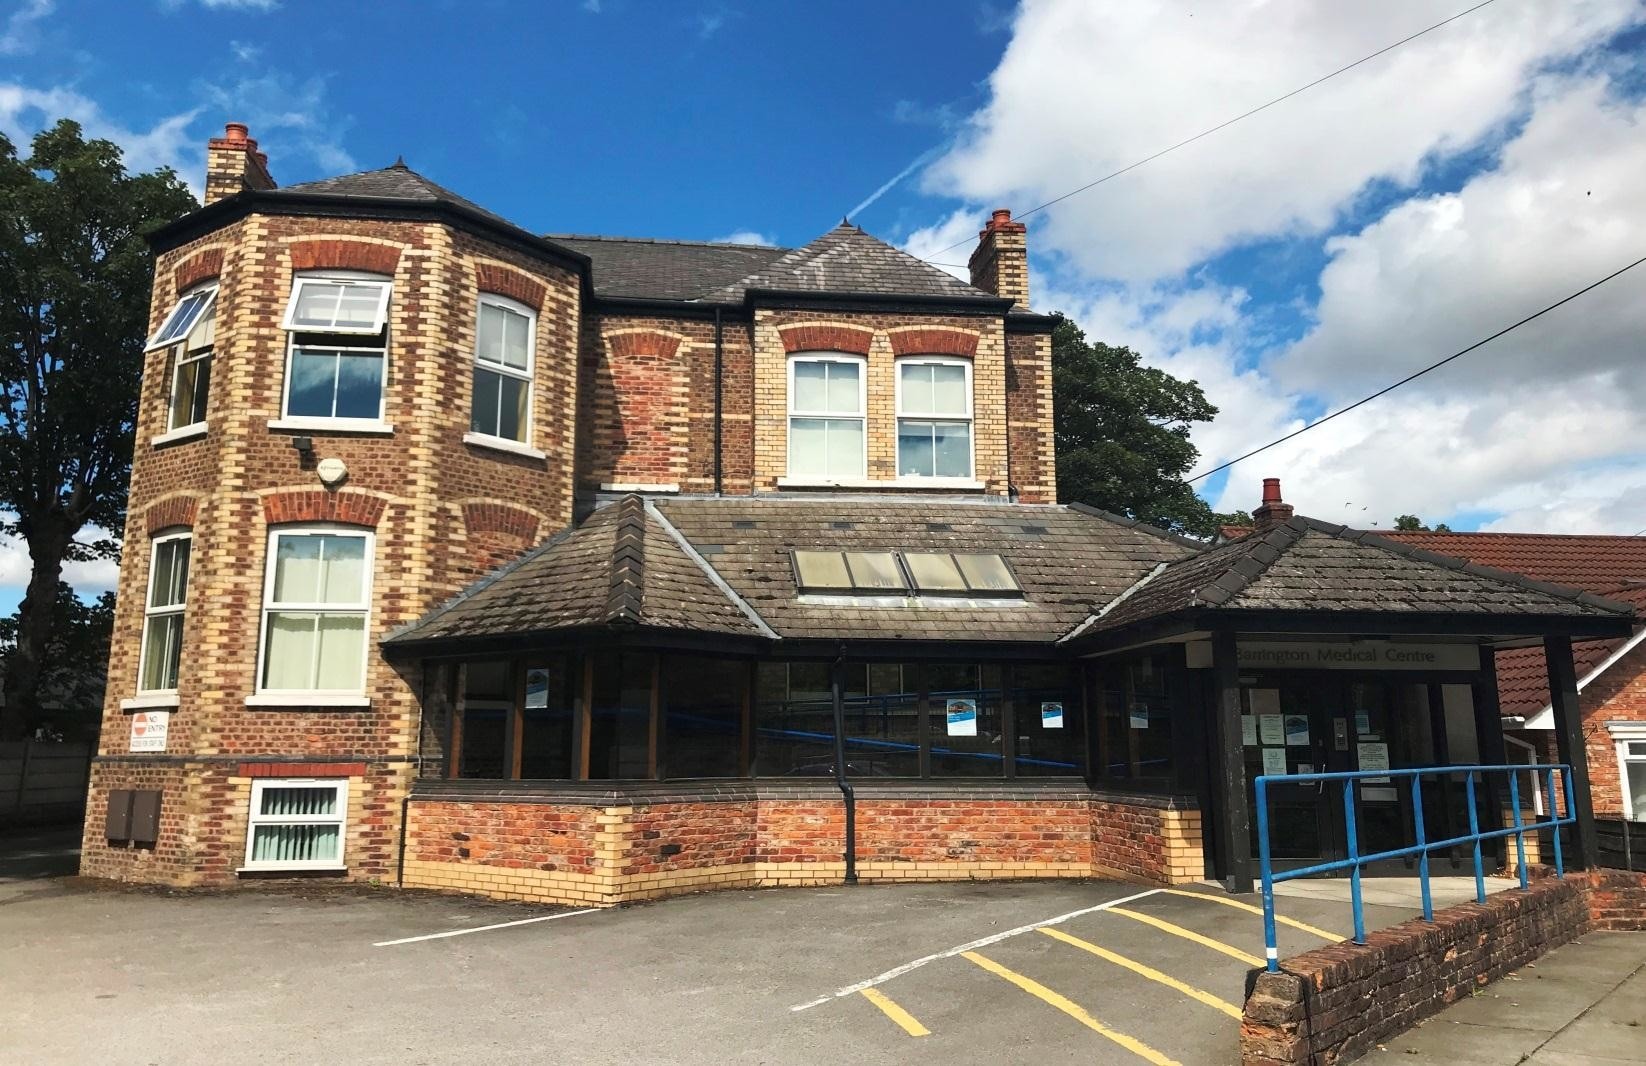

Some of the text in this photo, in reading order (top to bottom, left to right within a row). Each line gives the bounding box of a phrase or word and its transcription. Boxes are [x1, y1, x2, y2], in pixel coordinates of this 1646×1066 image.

[1318, 648, 1376, 662] Medical
[1385, 648, 1435, 662] Centre
[148, 724, 166, 733] ENTRY
